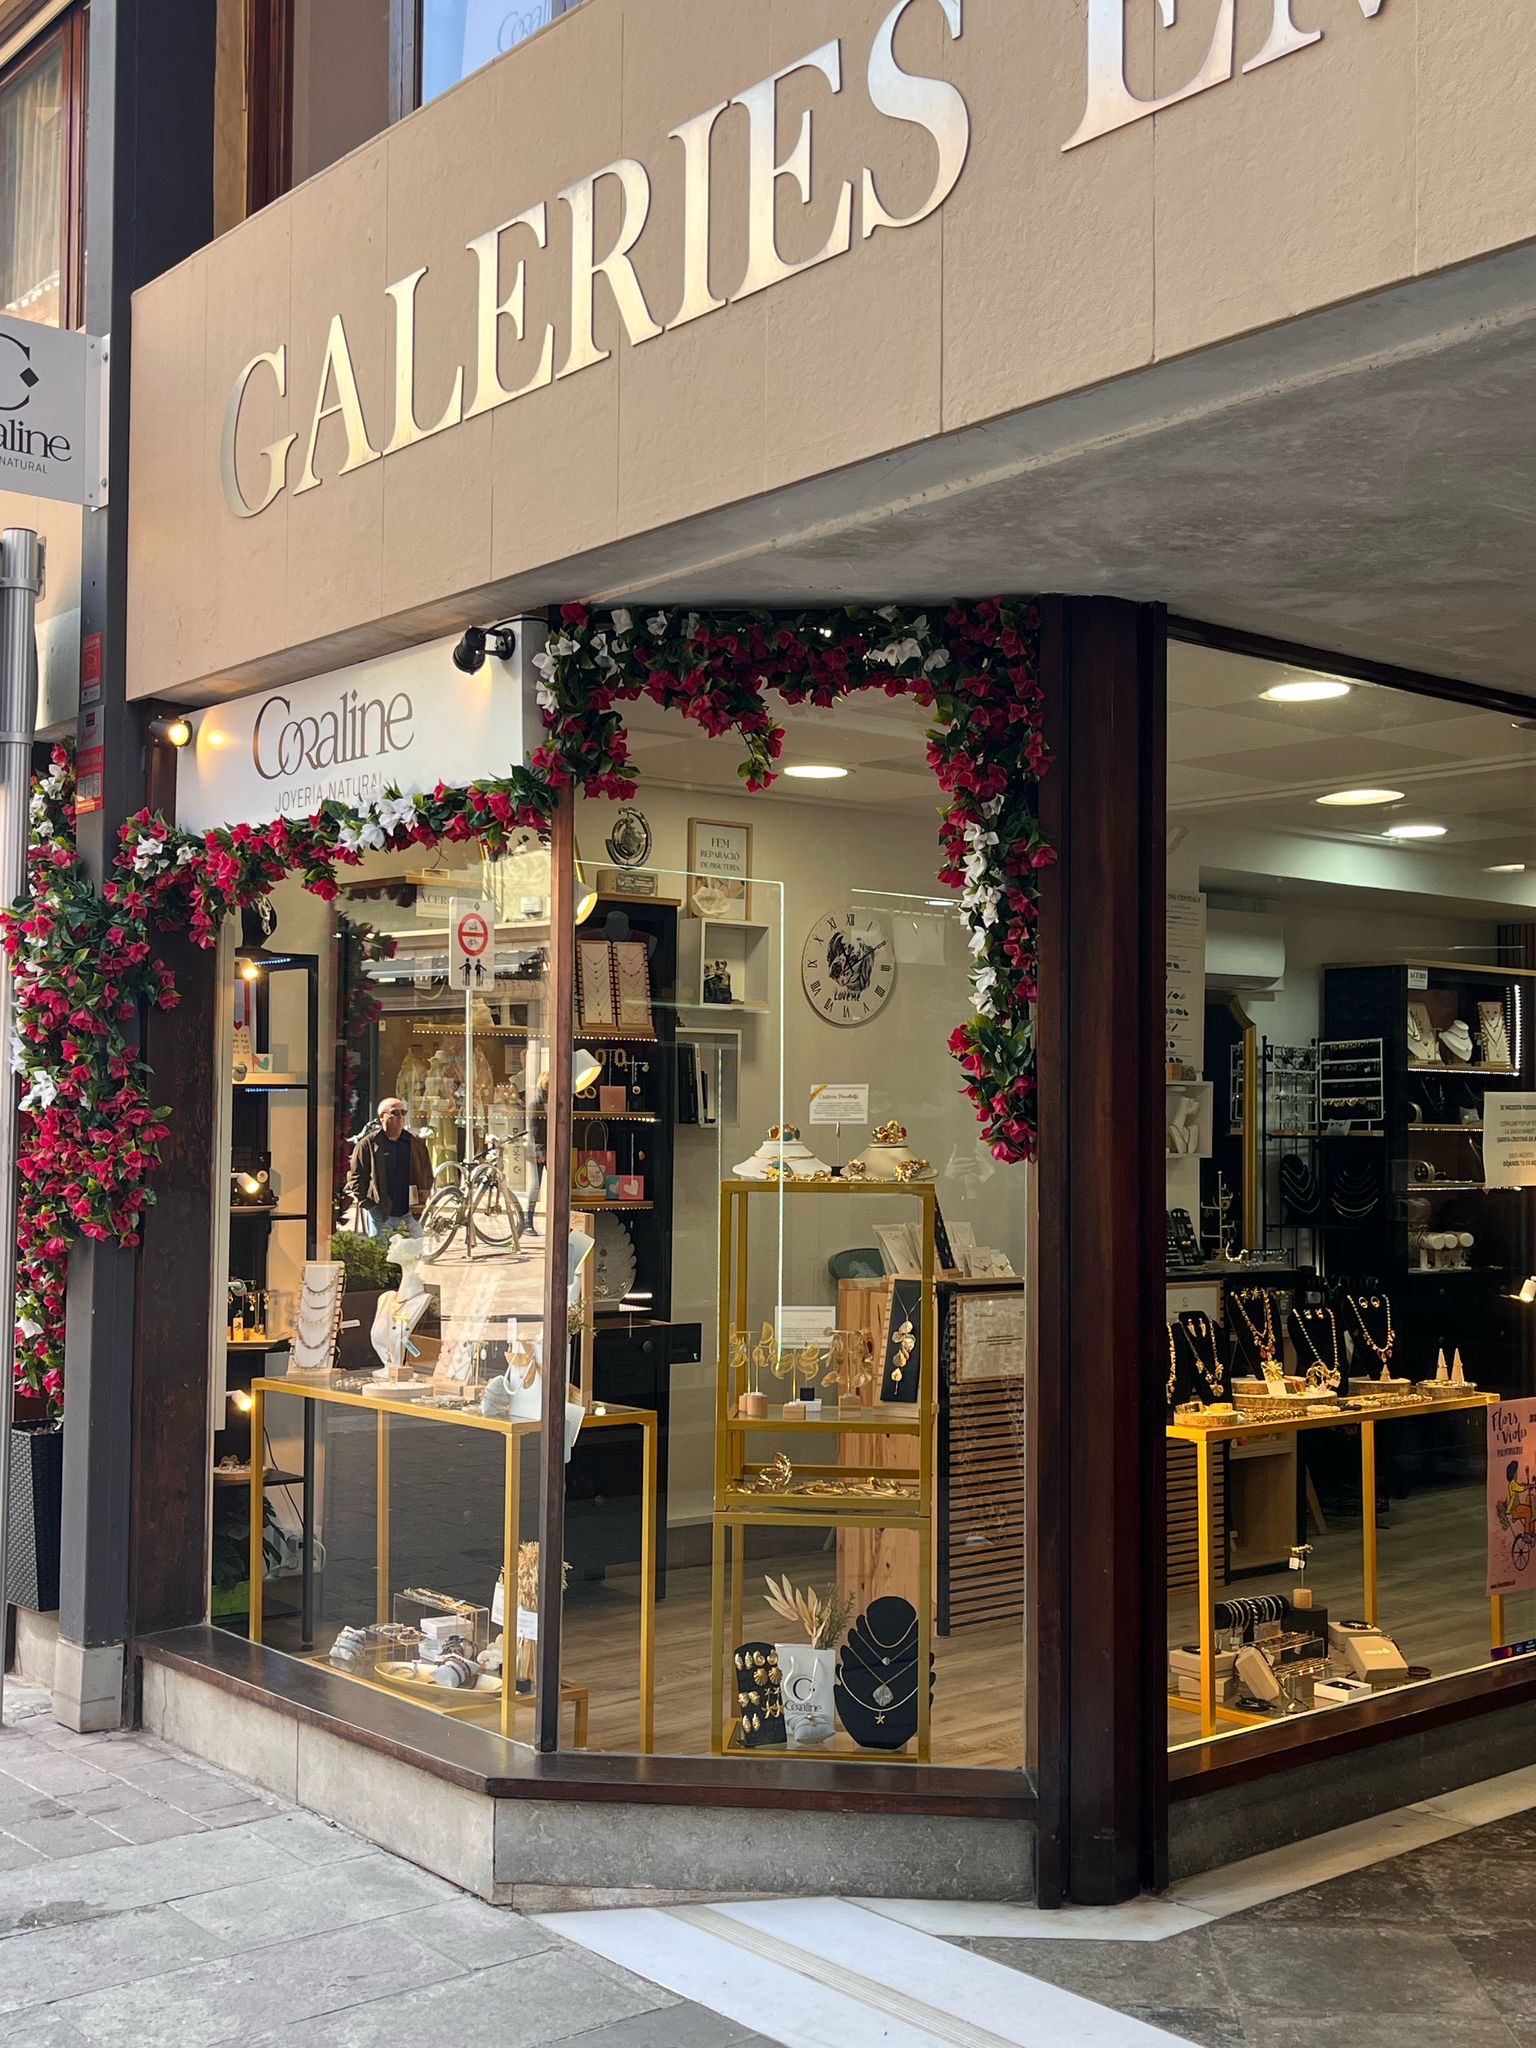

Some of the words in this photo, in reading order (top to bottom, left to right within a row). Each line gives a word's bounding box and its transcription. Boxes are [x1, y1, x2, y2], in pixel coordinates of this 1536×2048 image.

[220, 0, 970, 518] GALERIES
[0, 456, 48, 474] NATURAL
[252, 689, 415, 780] Coraline
[711, 837, 730, 848] FEM
